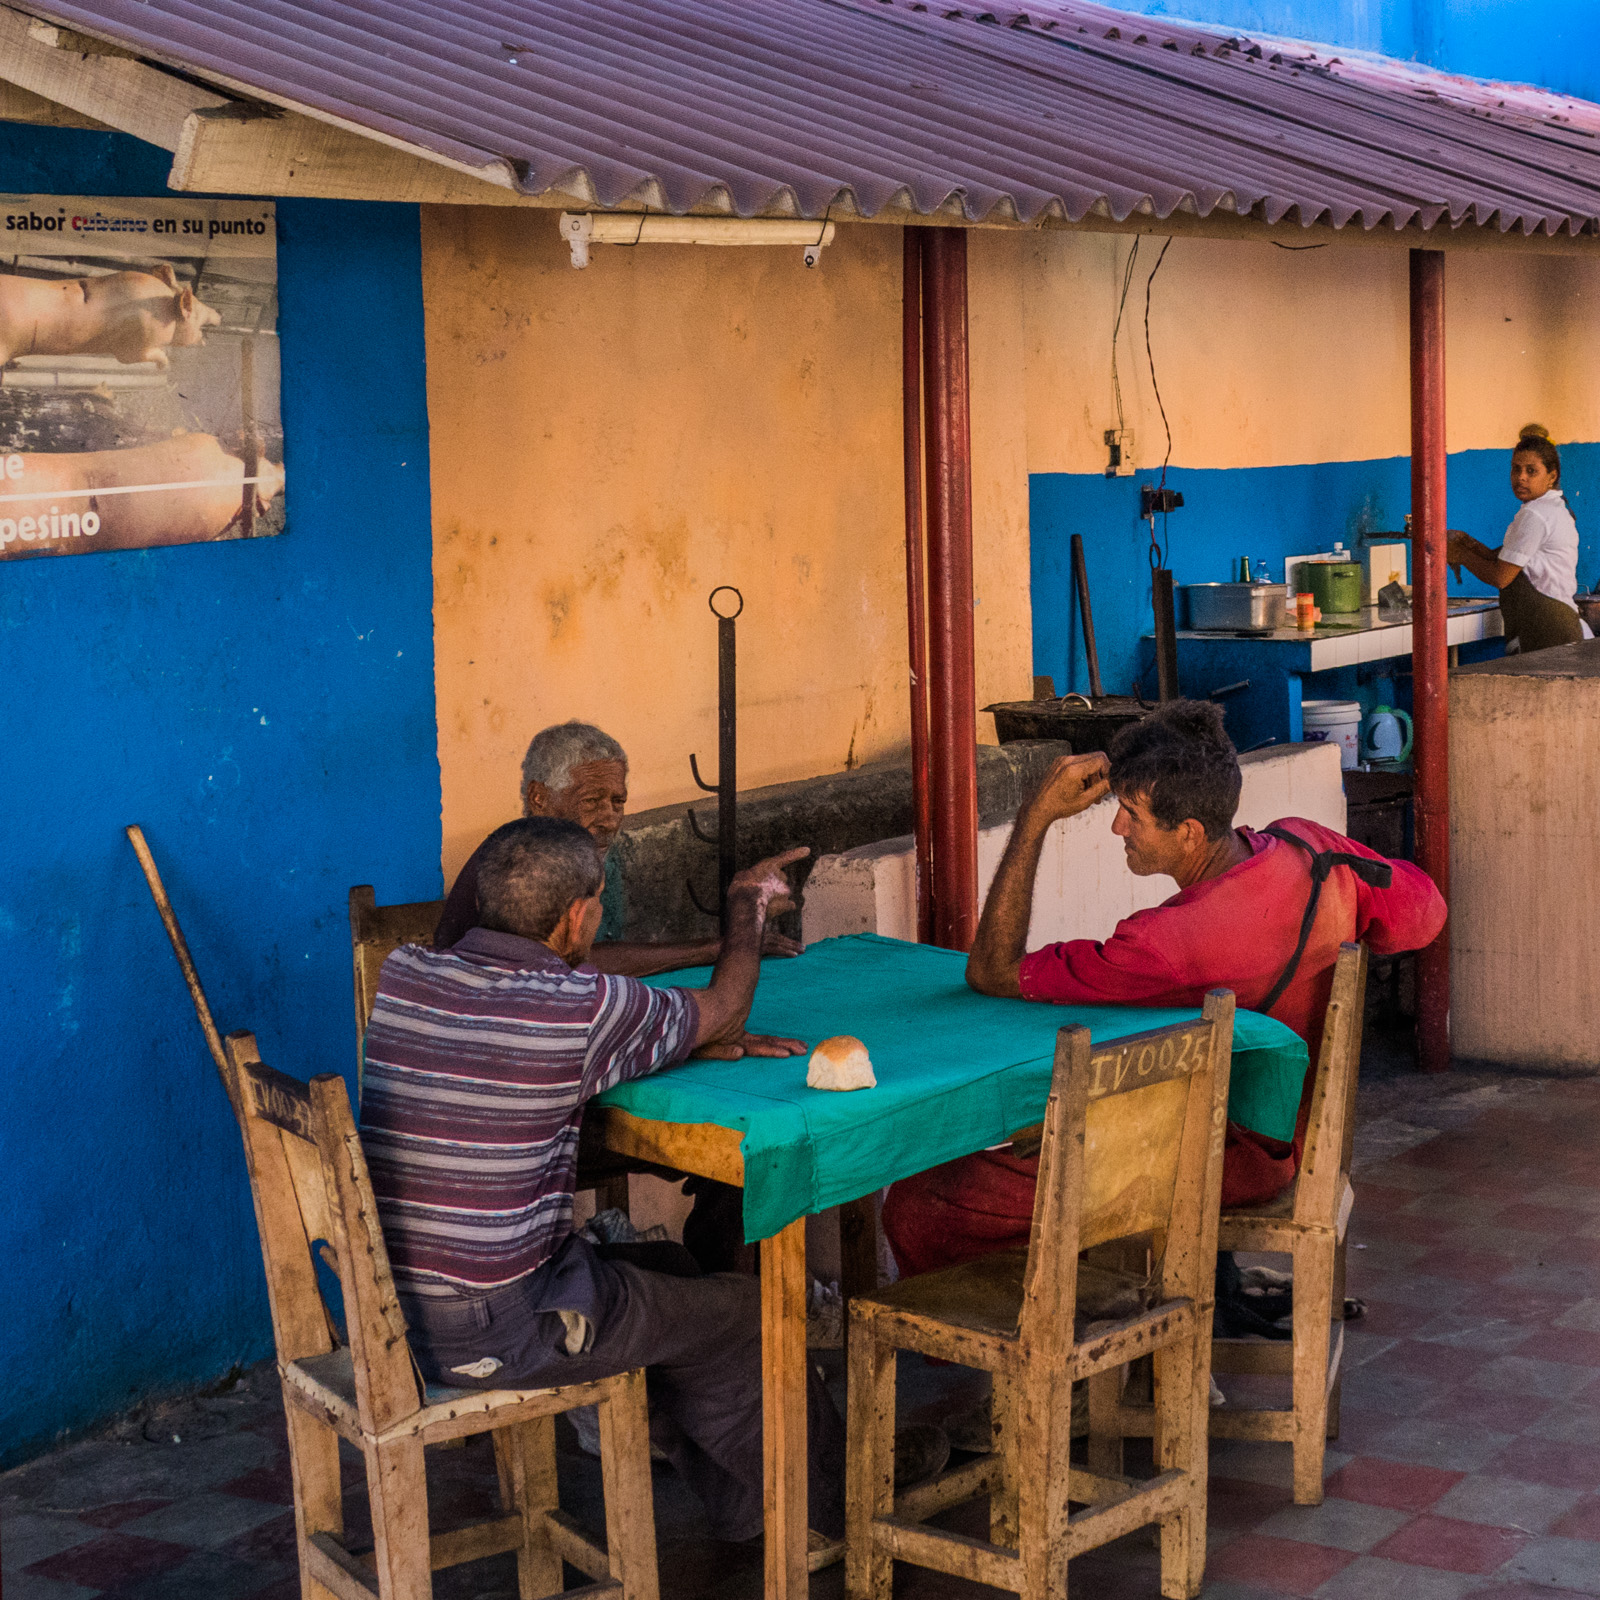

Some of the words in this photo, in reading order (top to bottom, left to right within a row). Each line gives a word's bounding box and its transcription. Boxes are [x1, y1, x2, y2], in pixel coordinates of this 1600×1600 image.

[6, 211, 66, 231] sabor
[71, 212, 148, 233] cubano
[153, 218, 177, 234] en
[182, 218, 203, 234] su
[208, 215, 266, 240] punto
[0, 454, 24, 480] e
[0, 506, 101, 550] pesino
